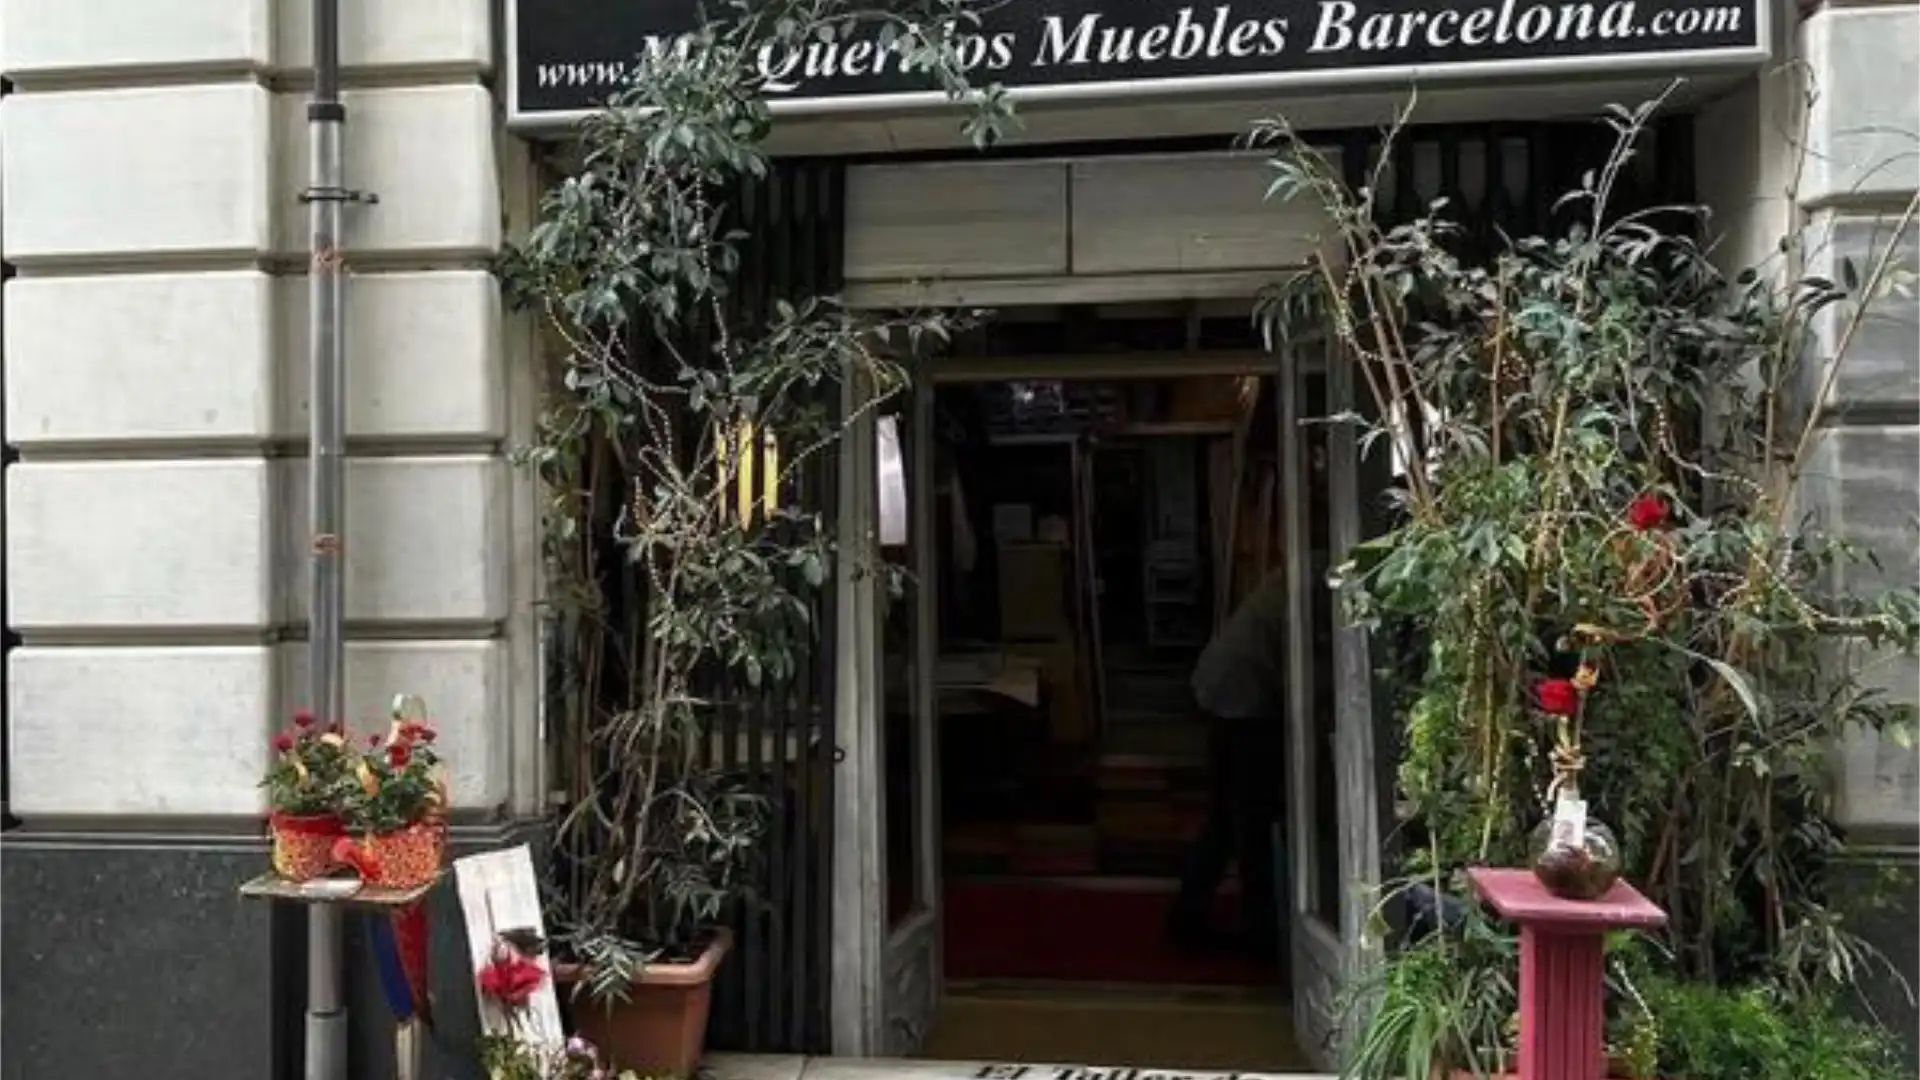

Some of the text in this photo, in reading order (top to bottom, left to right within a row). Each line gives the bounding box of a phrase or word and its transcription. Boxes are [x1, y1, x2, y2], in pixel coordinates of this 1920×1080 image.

[537, 34, 738, 88] www.M
[1032, 5, 1290, 67] Muebles
[1307, 0, 1742, 53] Barcelona.com
